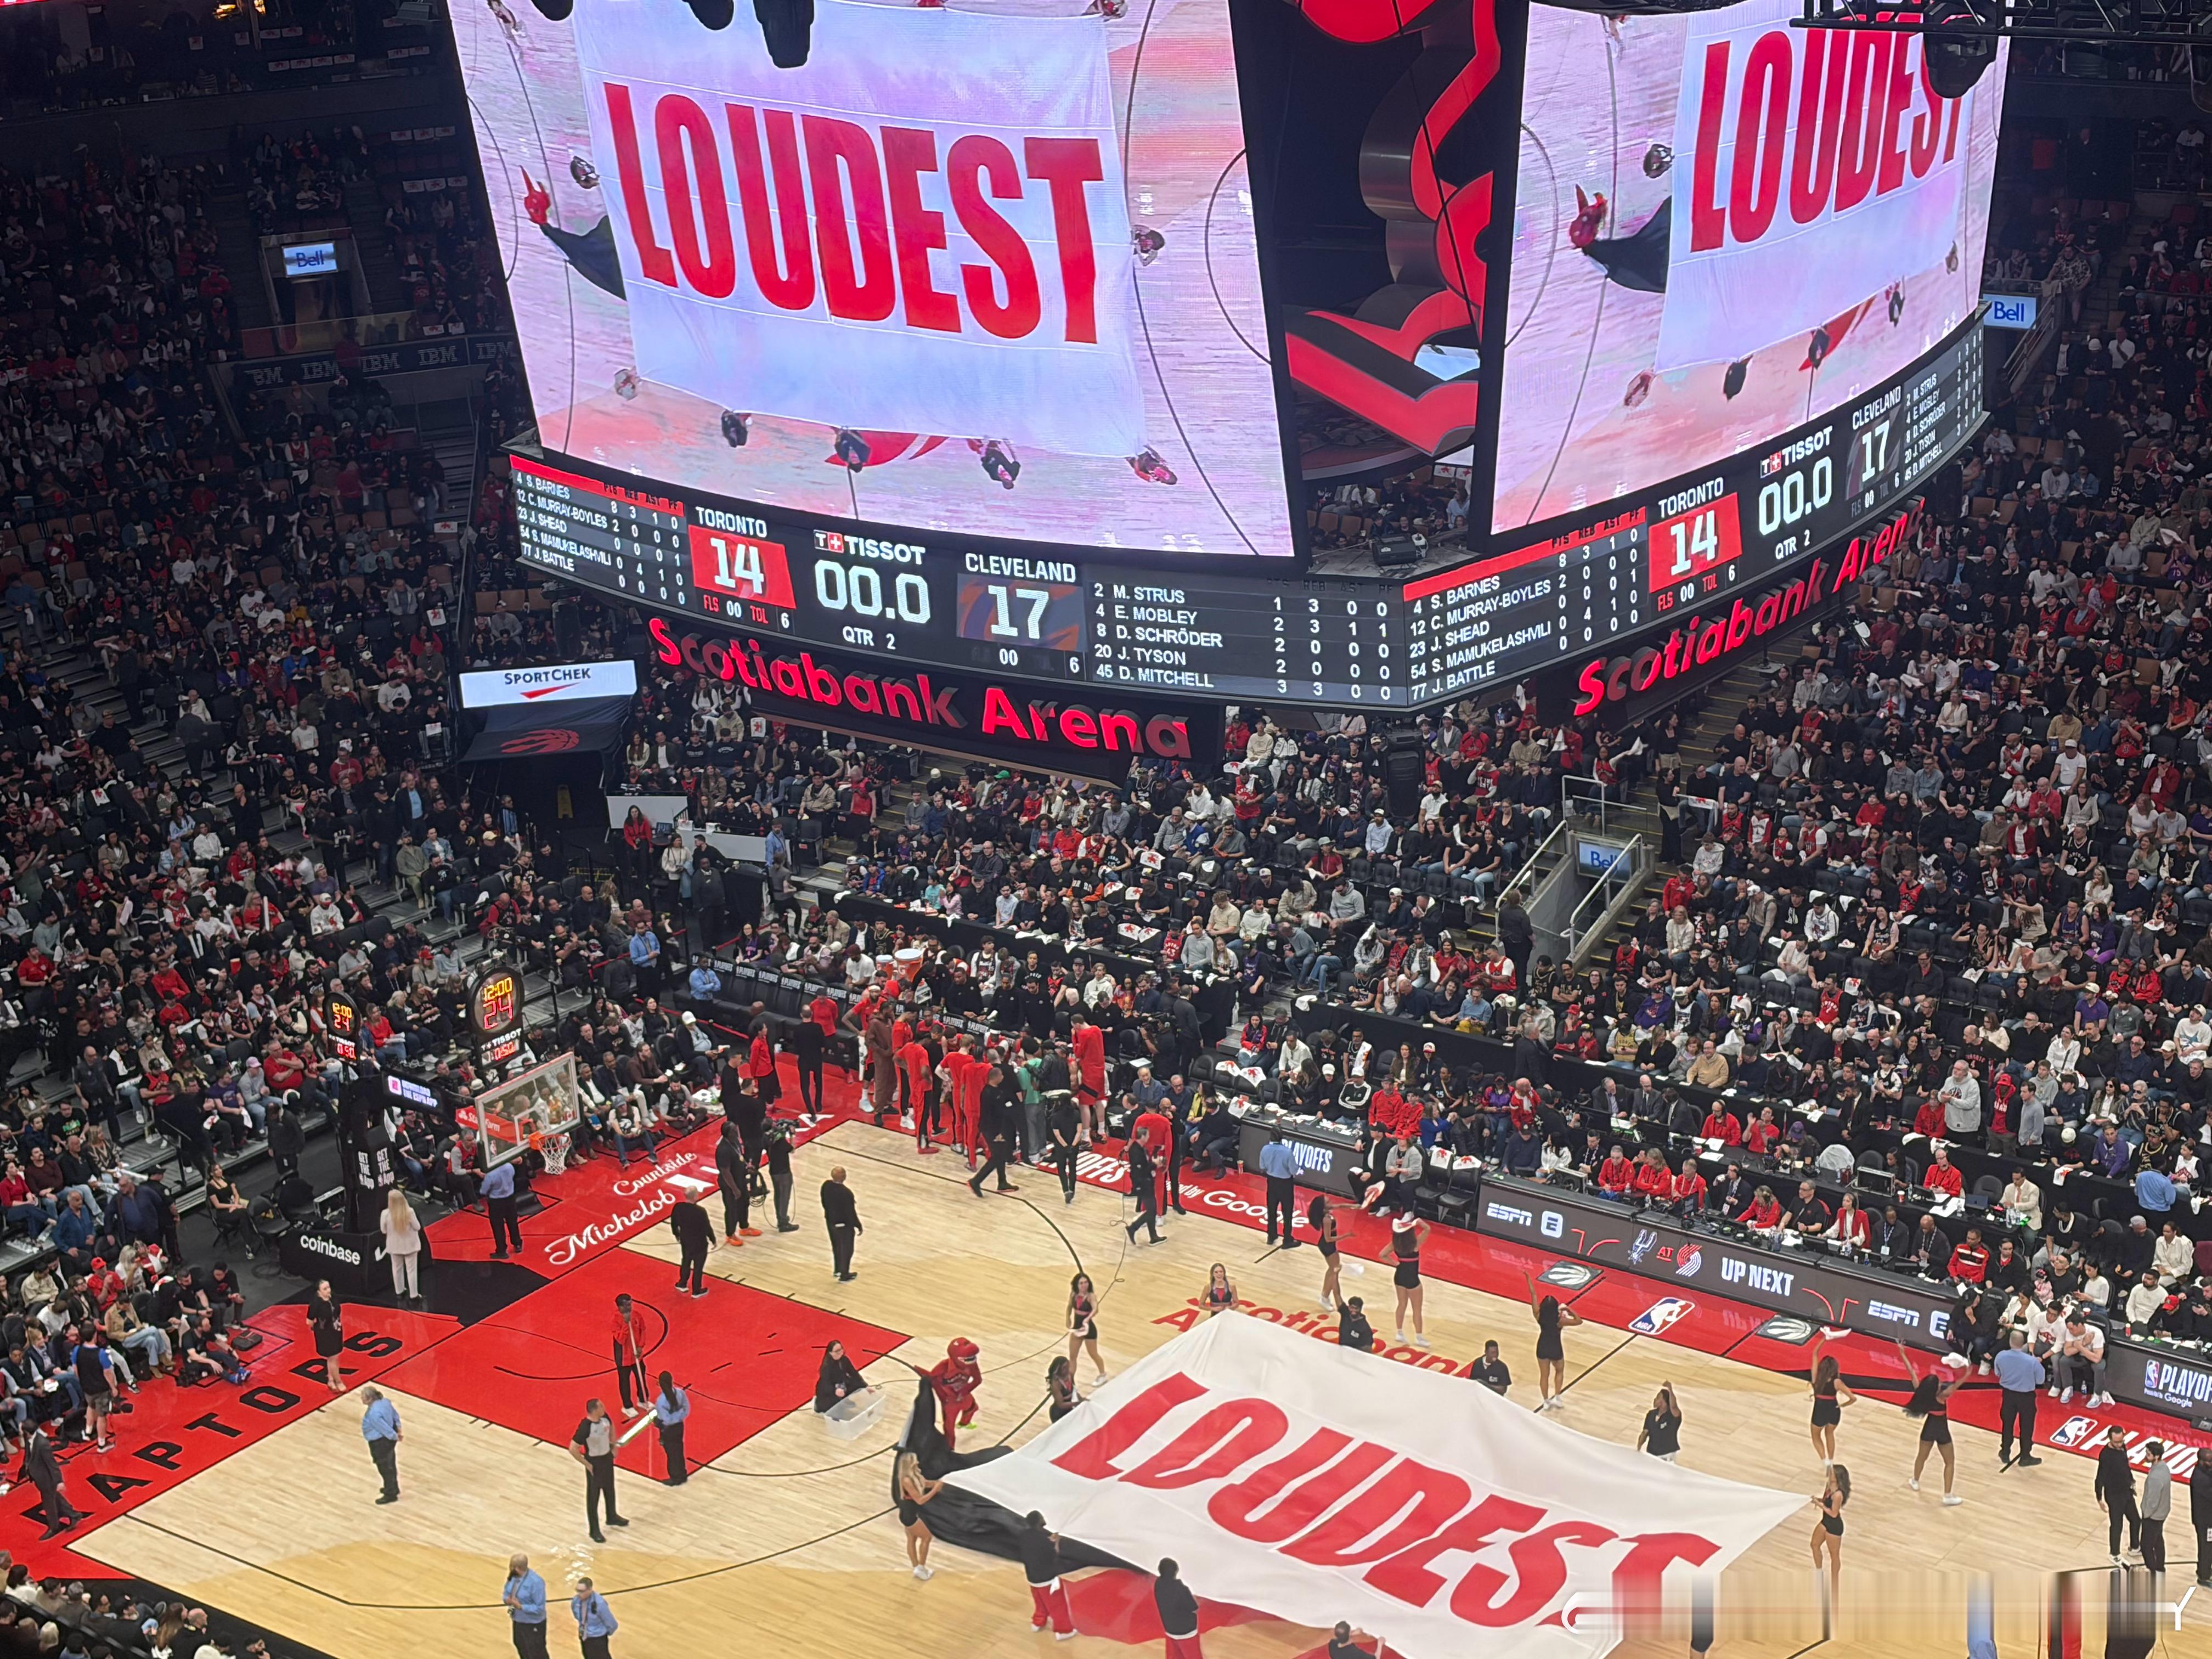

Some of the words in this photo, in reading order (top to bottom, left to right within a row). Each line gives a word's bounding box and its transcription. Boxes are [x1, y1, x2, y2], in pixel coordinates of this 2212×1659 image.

[602, 81, 1104, 345] LOUDEST
[296, 250, 324, 268] Bell
[1994, 302, 2024, 322] Bell
[361, 353, 400, 372] IBM
[417, 346, 458, 365] IBM
[1853, 386, 1901, 430] CLEVELAND
[1782, 425, 1832, 466] TISSOT
[1862, 420, 1889, 482] 17
[517, 473, 522, 484] 4
[536, 478, 570, 499] BARNES
[1658, 477, 1724, 518] TORONTO
[1759, 456, 1832, 535] 00.0
[1865, 490, 1874, 507] 00
[1895, 472, 1899, 488] 6
[517, 489, 526, 502] 12
[538, 496, 607, 528] MURRAY-BOYLES
[518, 506, 527, 519] 23
[539, 513, 567, 533] SHEAD
[696, 506, 768, 538] TORONTO
[520, 525, 529, 539] 54
[1671, 510, 1717, 575] 14
[1775, 537, 1797, 560] QTR
[1804, 529, 1810, 546] 2
[522, 543, 531, 556] 77
[543, 552, 574, 572] BATTLE
[710, 537, 764, 594] 14
[845, 535, 926, 565] TISSOT
[965, 552, 1076, 583] CLEVELAND
[815, 560, 931, 624] 00.0
[1094, 583, 1103, 597] 2
[1114, 585, 1130, 599] M.
[1134, 588, 1184, 603] STRUS
[1274, 597, 1281, 611] 1
[1309, 599, 1319, 612] 3
[1347, 601, 1357, 615] 0
[1376, 602, 1387, 616] 0
[1414, 601, 1422, 614] 4
[1431, 596, 1443, 609] S.
[1447, 576, 1500, 605] BARNES
[1657, 592, 1673, 612] FLS
[1680, 584, 1694, 602] 00
[1702, 574, 1717, 592] TOL
[1728, 565, 1735, 581] 6
[704, 595, 719, 612] FLS
[726, 601, 742, 618] 00
[751, 605, 768, 624] TOL
[781, 613, 789, 628] 6
[988, 585, 1049, 639] 17
[1096, 605, 1105, 617] 4
[1115, 606, 1129, 620] E.
[1133, 607, 1198, 625] MOBLEY
[1274, 617, 1284, 631] 2
[1310, 619, 1320, 633] 3
[1349, 622, 1356, 636] 1
[1379, 623, 1386, 637] 1
[1410, 620, 1425, 636] 12
[1431, 616, 1443, 630] C.
[1447, 579, 1551, 626] MURRAY-BOYLES
[1573, 558, 1830, 716] Scotiabank
[1832, 495, 1926, 594] Arena
[843, 626, 874, 646] QTR
[886, 634, 895, 650] 2
[1097, 624, 1107, 637] 8
[1117, 626, 1131, 640] D.
[1135, 628, 1223, 647] SCHRÖDER
[1410, 642, 1425, 658] 23
[1431, 637, 1442, 651] J.
[1446, 620, 1489, 647] SHEAD
[1411, 664, 1426, 679] 54
[1432, 659, 1443, 673] S.
[1447, 620, 1551, 668] MAMUKELASHVILI
[999, 649, 1018, 666] 00
[1070, 657, 1080, 673] 6
[1095, 644, 1111, 658] 20
[1118, 647, 1130, 661] J.
[1133, 647, 1186, 665] TYSON
[505, 668, 591, 685] SPORTCHEK
[648, 616, 967, 729] Scotiabank
[981, 687, 1192, 759] Arena
[1097, 664, 1113, 678] 45
[1120, 667, 1135, 681] D.
[1138, 669, 1214, 688] MITCHELL
[1412, 683, 1426, 701] 77
[1432, 679, 1443, 693] J.
[1447, 661, 1495, 690] BATTLE
[484, 977, 512, 1001] 12:00
[334, 1014, 350, 1031] 24
[483, 994, 512, 1029] 24
[492, 1028, 521, 1046] TISSOT
[358, 1151, 368, 1163] GET
[359, 1163, 371, 1175] THE
[377, 1148, 387, 1162] GET
[378, 1159, 390, 1173] THE
[613, 1152, 697, 1195] Courtside
[1203, 1190, 1309, 1228] Googe
[544, 1189, 676, 1265] Michelob
[300, 1235, 360, 1265] coinbase
[1487, 1202, 1532, 1226] ESPN
[1657, 1248, 1674, 1257] AT
[1722, 1257, 1745, 1282] UP
[1748, 1264, 1795, 1296] NEXT
[1635, 1321, 1653, 1331] NBA
[1867, 1300, 1920, 1327] ESPN
[2164, 1392, 2192, 1408] Google
[1049, 1371, 1723, 1628] LOUDEST
